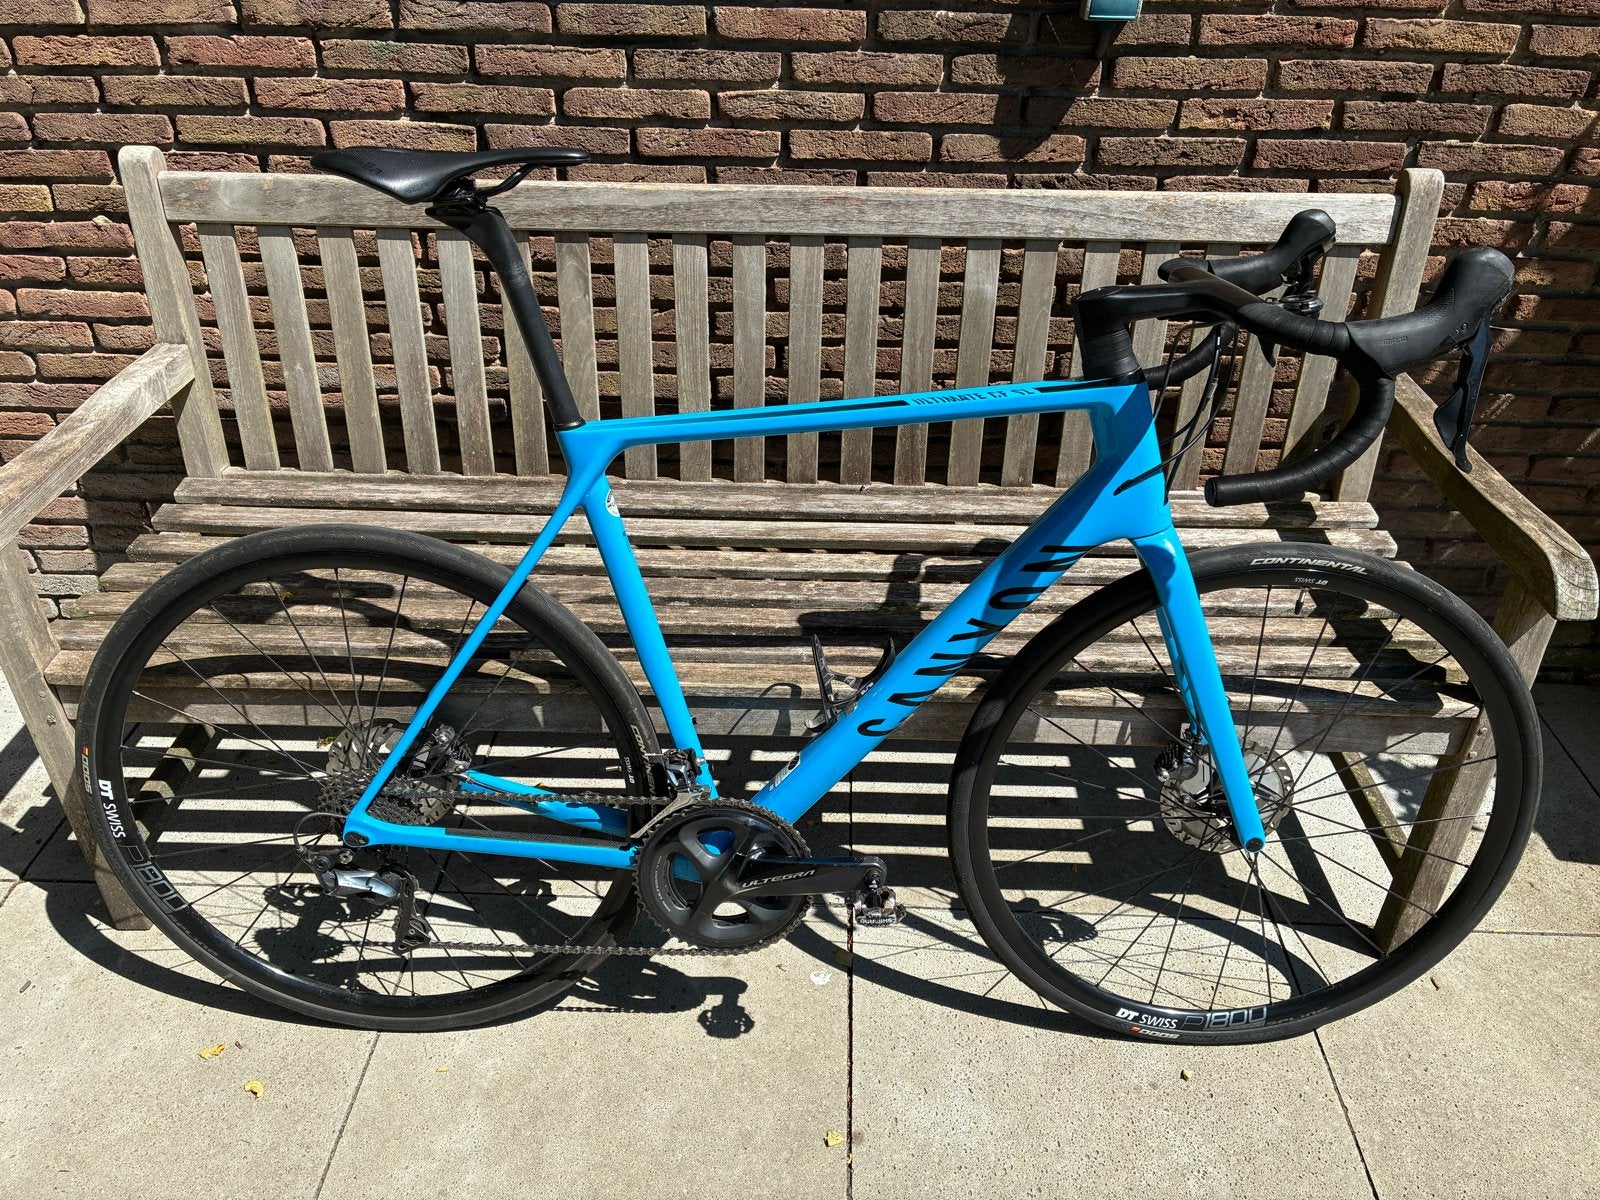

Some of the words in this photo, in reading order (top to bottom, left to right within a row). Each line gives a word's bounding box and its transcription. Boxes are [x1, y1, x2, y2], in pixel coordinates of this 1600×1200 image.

[911, 393, 986, 405] ULTIMATE
[988, 390, 1008, 399] CF
[1011, 388, 1035, 396] SL
[1249, 557, 1367, 575] CONTINENTAL
[1294, 577, 1315, 585] SWISS
[98, 779, 114, 800] DT
[103, 802, 126, 839] SWISS
[117, 845, 190, 913] P1800
[742, 869, 815, 888] ULTEGRA
[1115, 1007, 1139, 1022] DT
[1139, 1013, 1178, 1030] SWISS
[1179, 1006, 1267, 1031] P1800
